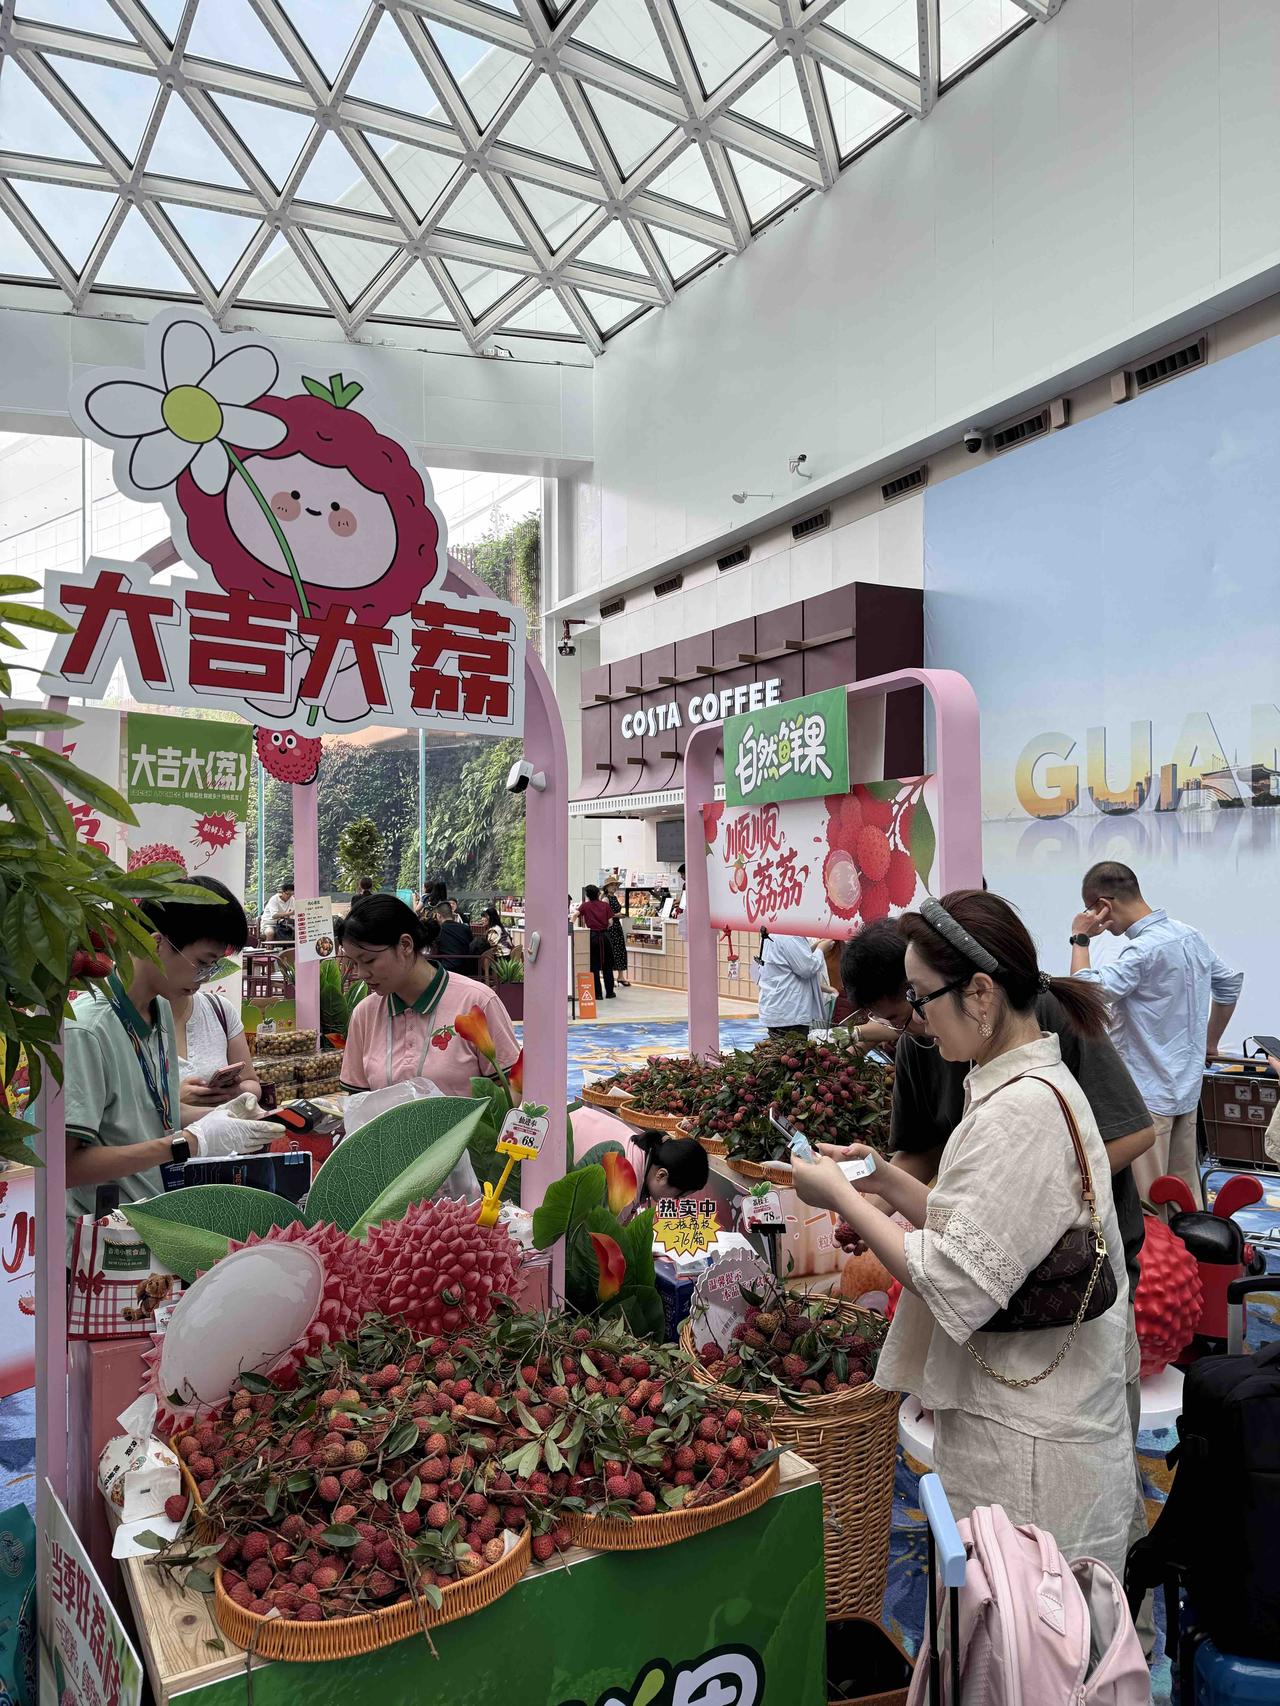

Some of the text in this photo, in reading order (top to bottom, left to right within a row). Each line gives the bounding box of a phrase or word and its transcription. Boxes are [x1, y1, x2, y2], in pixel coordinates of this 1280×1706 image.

[60, 571, 512, 720] 大吉大荔
[621, 678, 782, 739] COSTA COFFEE
[735, 714, 833, 797] 自然鲜果
[522, 1135, 535, 1147] 68
[659, 1198, 716, 1218] 热卖中
[764, 1211, 775, 1222] 78
